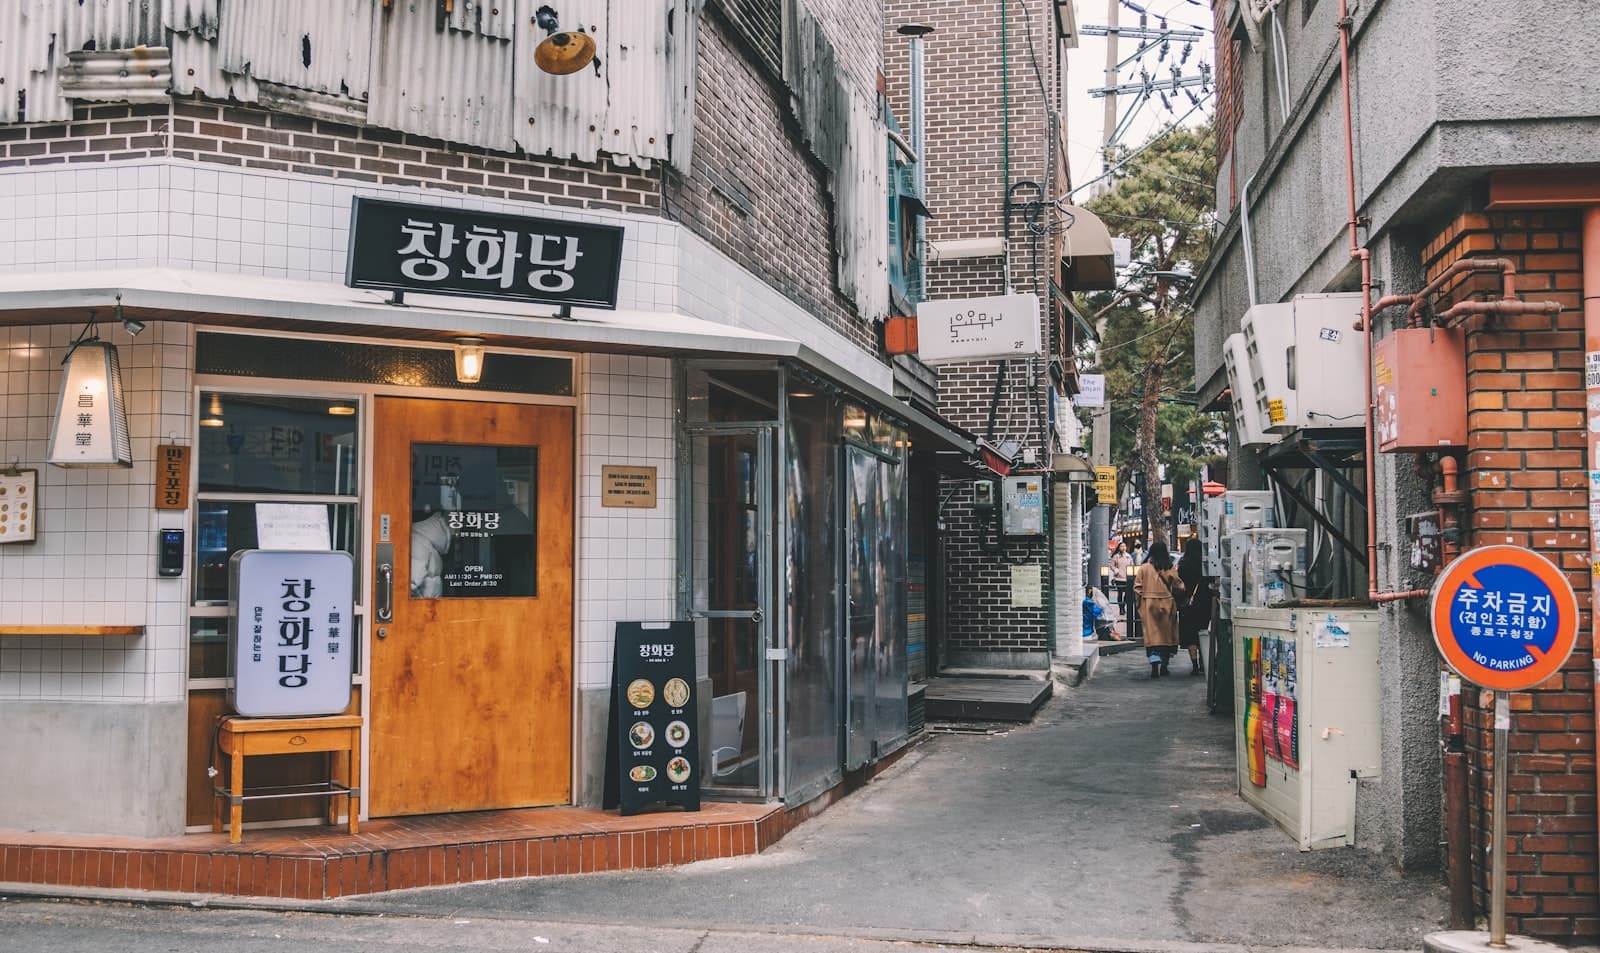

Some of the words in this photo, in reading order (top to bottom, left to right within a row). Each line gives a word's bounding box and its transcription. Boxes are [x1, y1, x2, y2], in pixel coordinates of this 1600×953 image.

[397, 218, 584, 293] 창화당
[1014, 341, 1024, 349] 2F
[166, 447, 182, 505] 만두포장
[449, 511, 500, 529] 창화당
[1458, 588, 1550, 616] 주차금지
[1459, 611, 1547, 630] (견인조치함)
[278, 578, 316, 688] 창화당
[1470, 626, 1535, 640] 종로구청장
[1473, 651, 1488, 665] NO
[1489, 654, 1534, 670] PARKING
